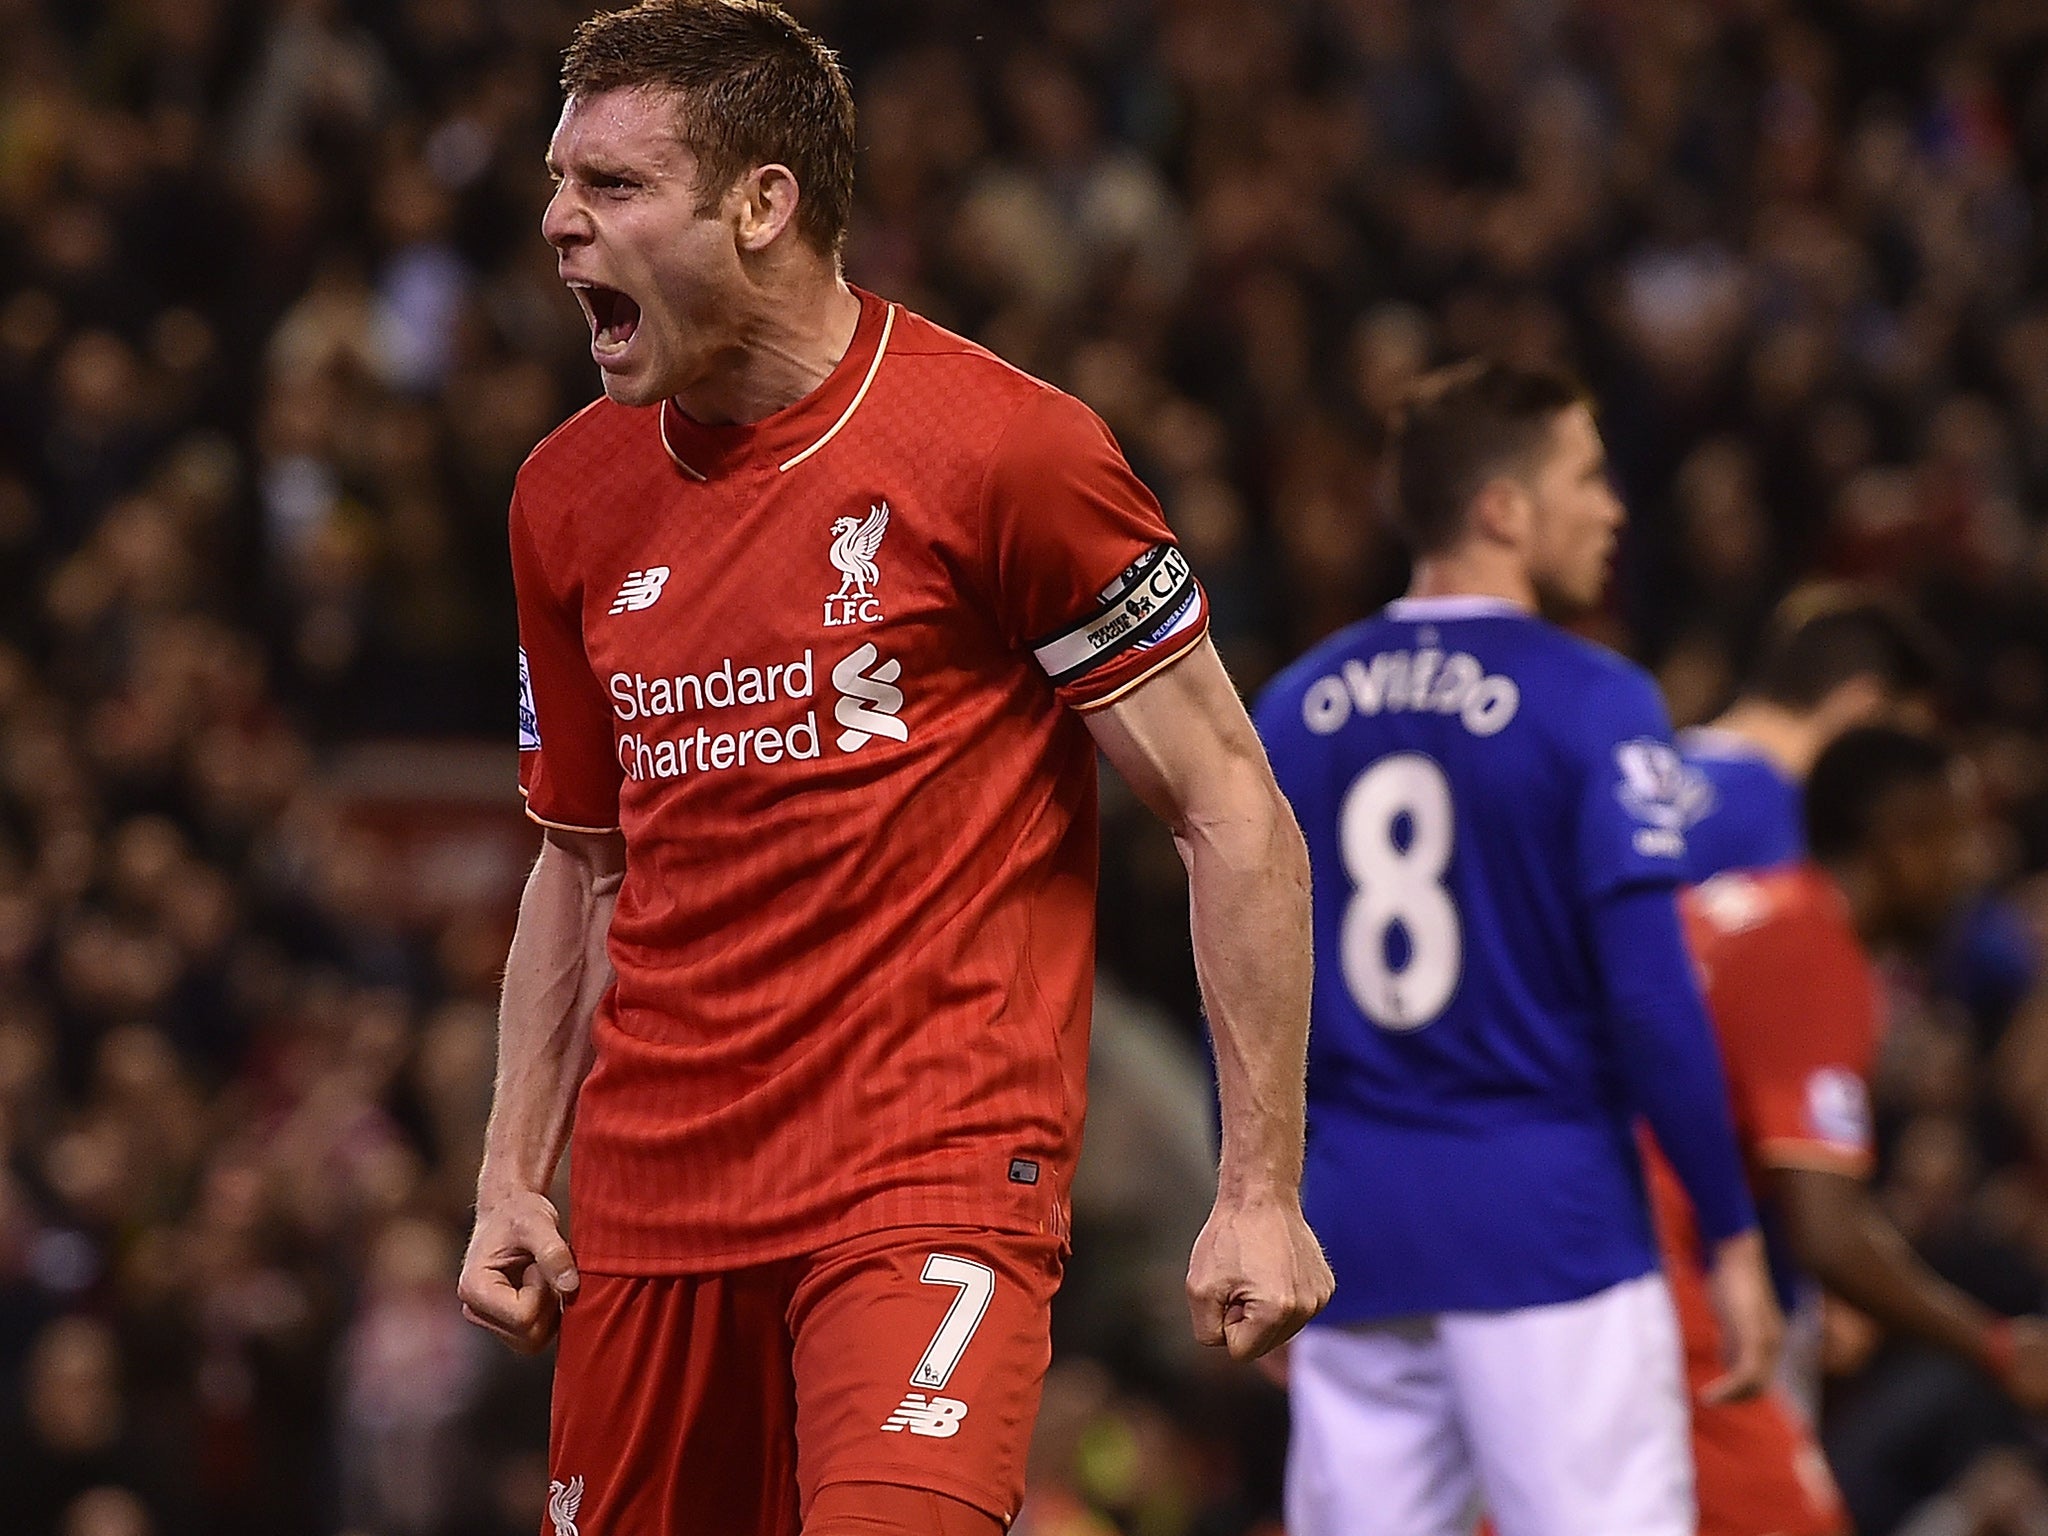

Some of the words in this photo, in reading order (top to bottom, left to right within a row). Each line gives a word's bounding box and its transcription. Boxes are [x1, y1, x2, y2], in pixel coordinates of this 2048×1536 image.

[823, 600, 884, 627] L.F.C.
[1087, 613, 1130, 643] PREMIER
[1093, 620, 1132, 649] LEAGUE
[1152, 610, 1182, 640] PREMIER
[610, 649, 813, 721] Standard
[618, 711, 820, 781] Chartered
[1338, 751, 1463, 1034] 8
[910, 1253, 996, 1390] 7
